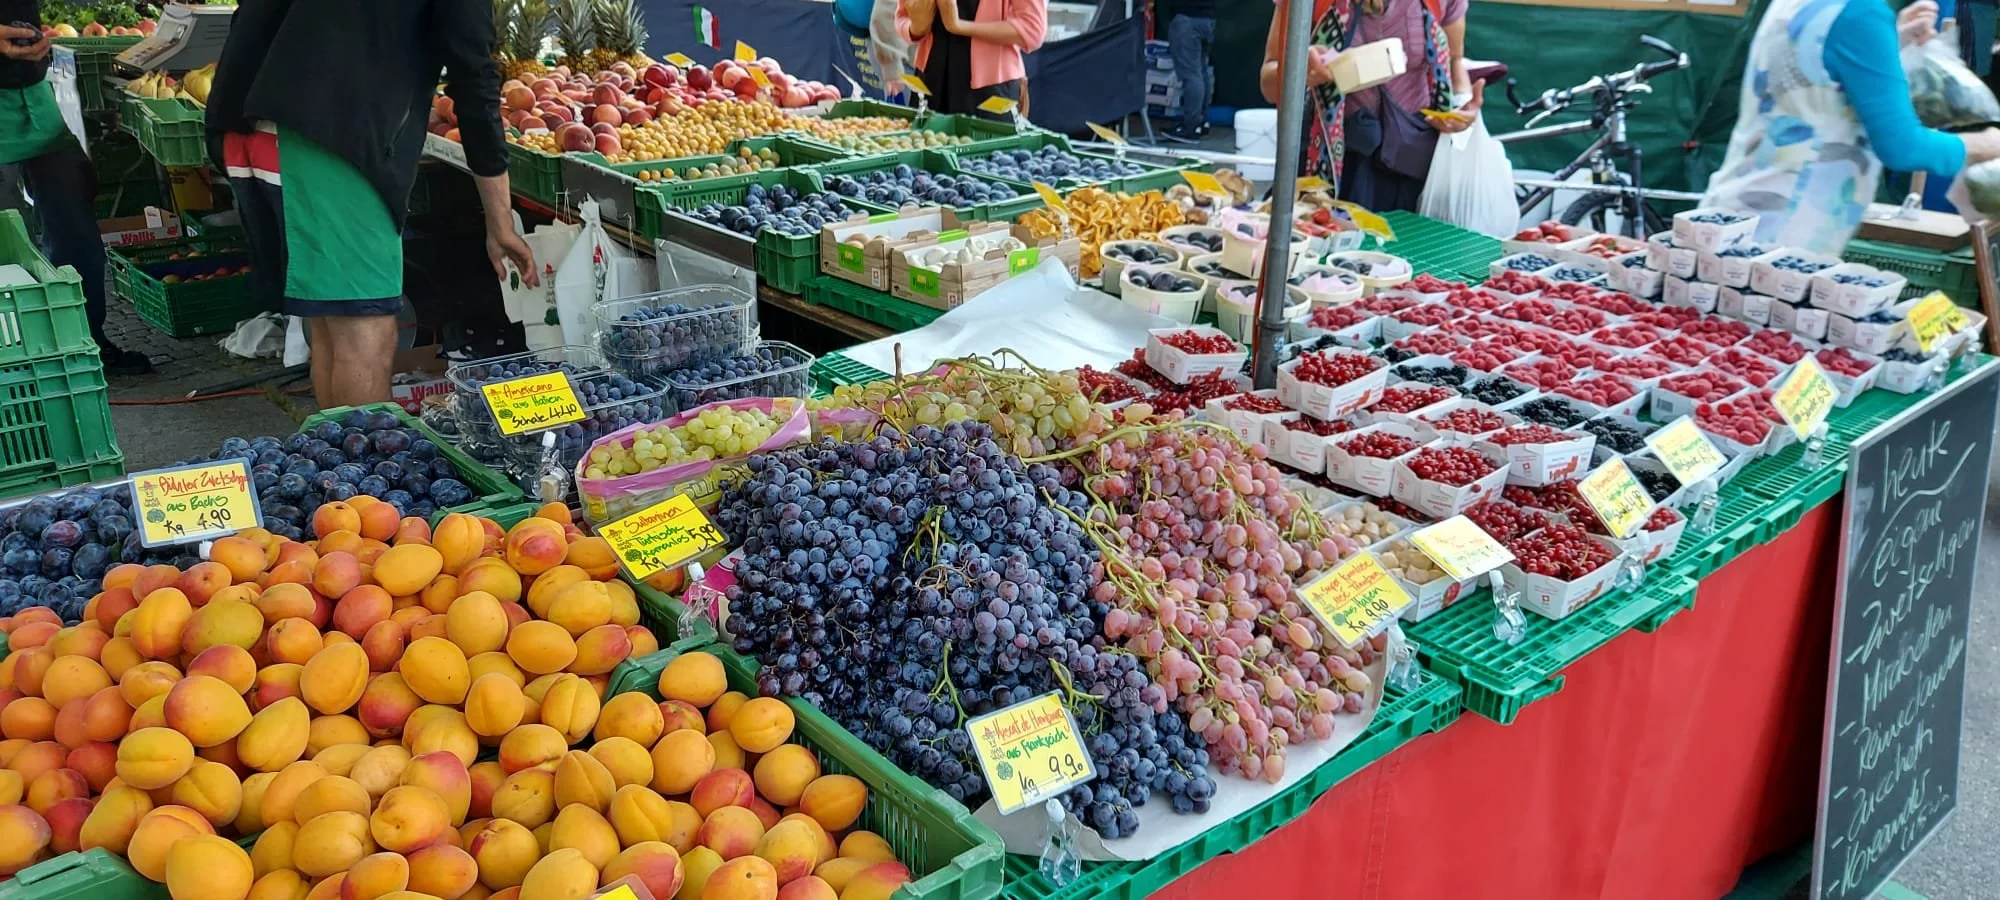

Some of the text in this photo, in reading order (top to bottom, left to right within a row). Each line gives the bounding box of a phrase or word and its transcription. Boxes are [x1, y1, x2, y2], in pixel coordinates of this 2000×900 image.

[121, 231, 156, 245] Wallis
[410, 382, 456, 400] Wallis
[512, 412, 549, 429] Schale
[1883, 420, 1951, 513] heute
[167, 502, 187, 511] aus
[164, 508, 232, 536] Kg 4.90
[640, 556, 668, 571] Kg
[1345, 617, 1374, 634] Kg
[1006, 746, 1021, 760] aus
[1018, 770, 1042, 798] Kg
